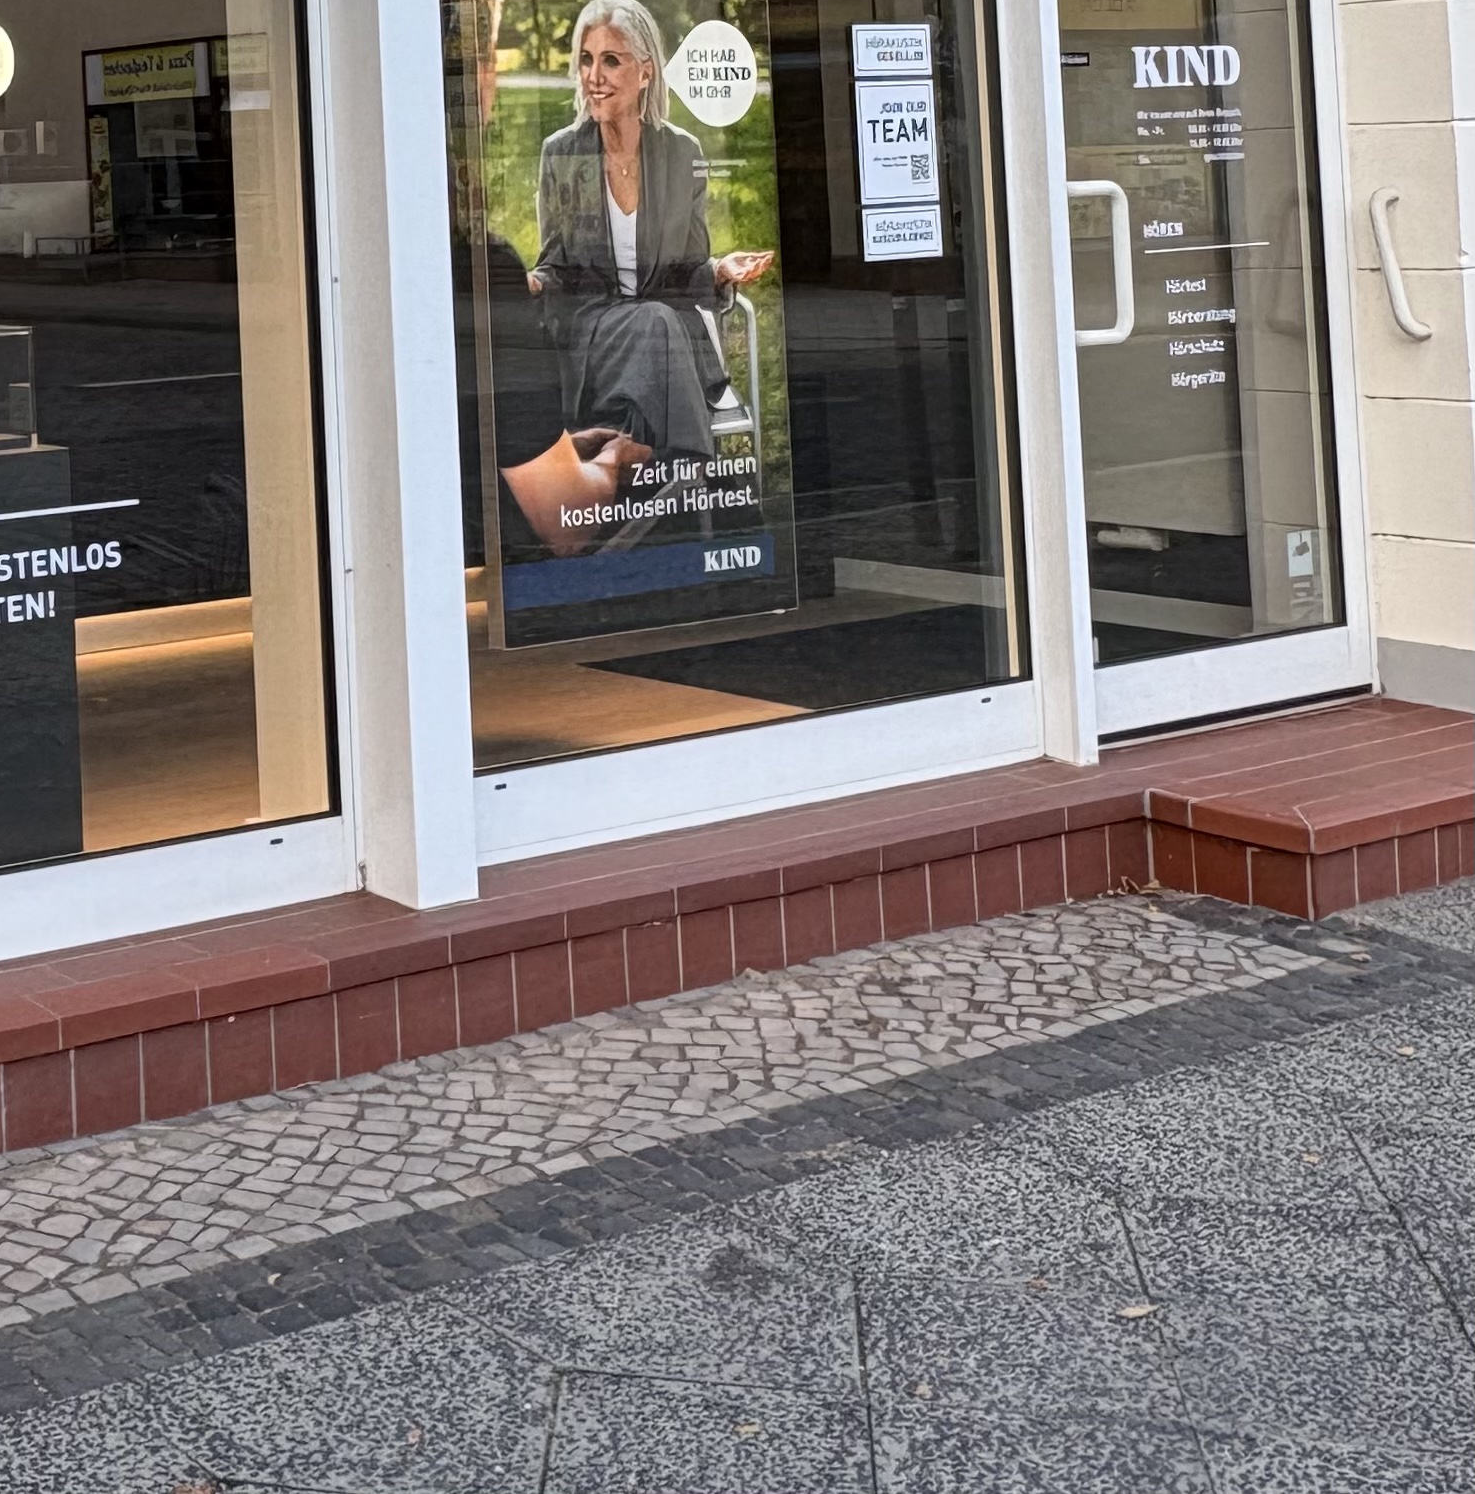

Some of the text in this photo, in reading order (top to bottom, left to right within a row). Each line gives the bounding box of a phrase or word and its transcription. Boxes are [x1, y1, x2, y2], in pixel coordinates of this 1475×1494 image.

[687, 49, 736, 63] ICH HAB
[1130, 44, 1242, 90] KIND
[688, 66, 752, 81] EIN KIND
[866, 117, 929, 144] TEAM
[630, 455, 758, 487] Zeit für einen
[560, 484, 760, 528] kostenlosen Hörtest.
[703, 545, 762, 573] KIND
